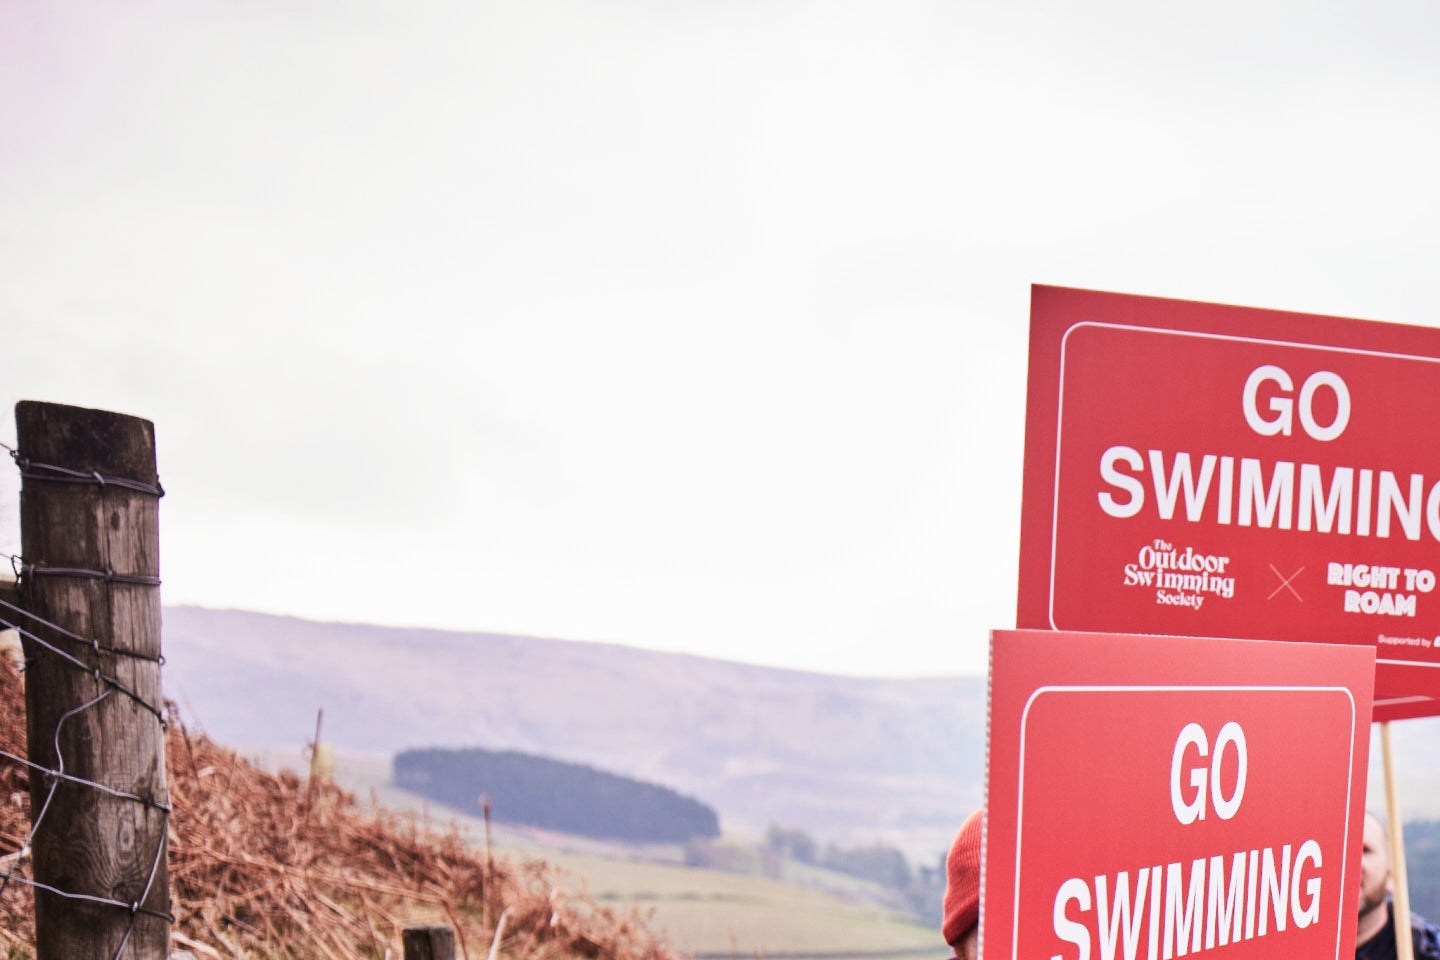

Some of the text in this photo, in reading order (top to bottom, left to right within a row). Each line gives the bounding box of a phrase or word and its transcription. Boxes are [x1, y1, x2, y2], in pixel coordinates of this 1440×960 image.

[1243, 365, 1351, 441] GO
[1154, 538, 1172, 551] The
[1138, 546, 1230, 573] Outdoor
[1123, 564, 1235, 598] Swimming
[1327, 562, 1436, 593] RIGHT TO
[1156, 590, 1204, 610] Society
[1344, 590, 1417, 617] ROAM
[1377, 634, 1420, 648] Supported
[1421, 637, 1432, 649] by
[1170, 721, 1248, 825] GO
